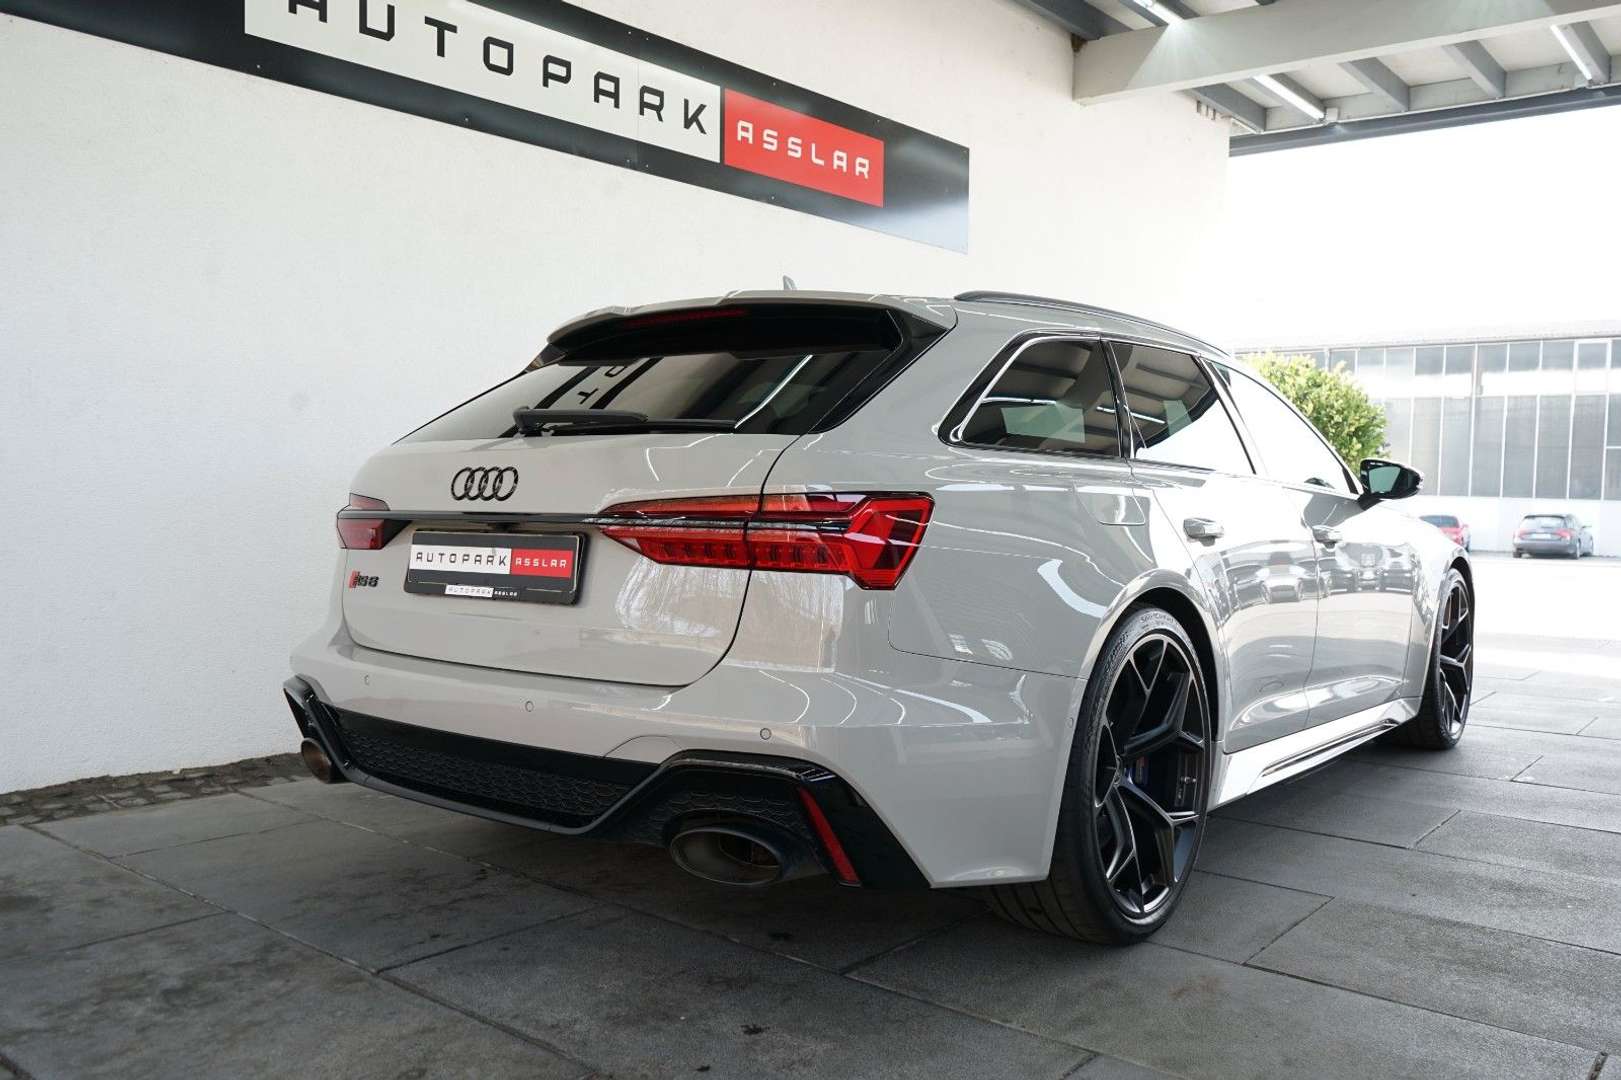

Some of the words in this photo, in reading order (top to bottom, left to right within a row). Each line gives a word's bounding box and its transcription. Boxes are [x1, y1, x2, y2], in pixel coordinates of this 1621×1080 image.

[737, 119, 870, 179] ASSLAR
[416, 551, 507, 567] AUTOPARK
[515, 557, 567, 569] ASSLAR
